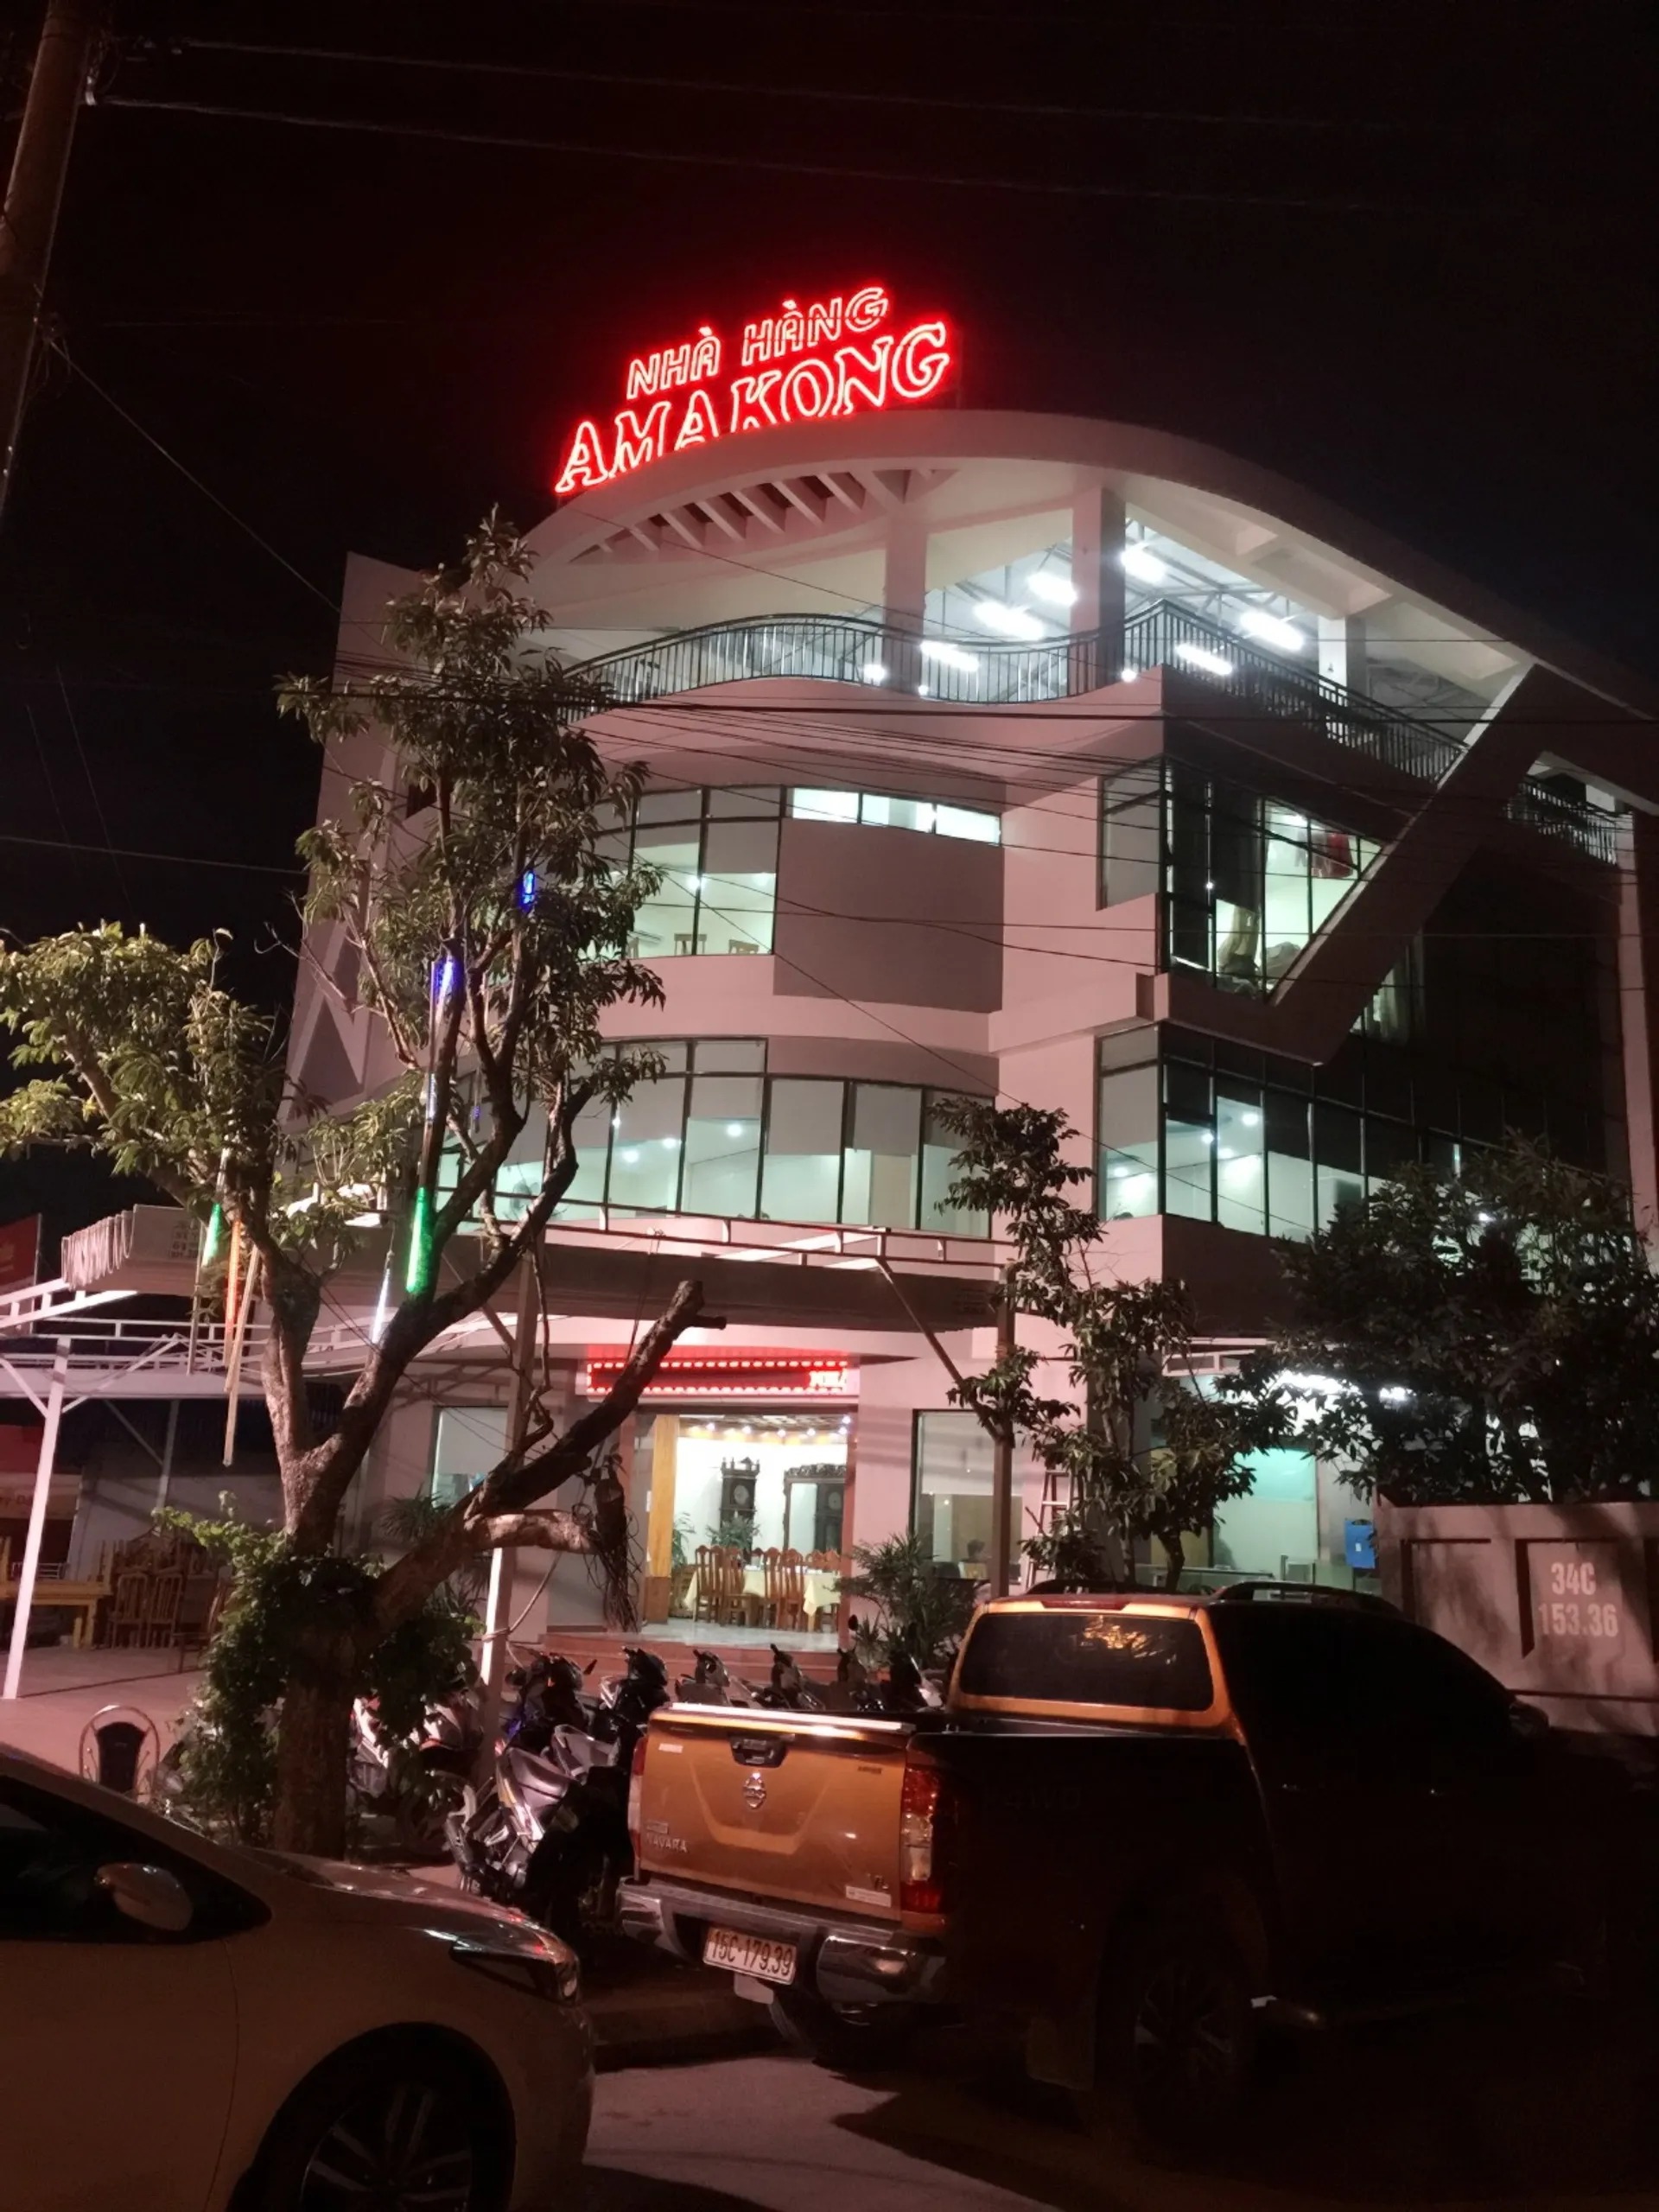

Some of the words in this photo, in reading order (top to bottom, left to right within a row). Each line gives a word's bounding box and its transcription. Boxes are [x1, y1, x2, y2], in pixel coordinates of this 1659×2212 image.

[626, 326, 721, 400] NHÀ
[741, 287, 889, 367] HÀNG
[1551, 1562, 1596, 1595] 34C
[1539, 1604, 1618, 1637] 153.36
